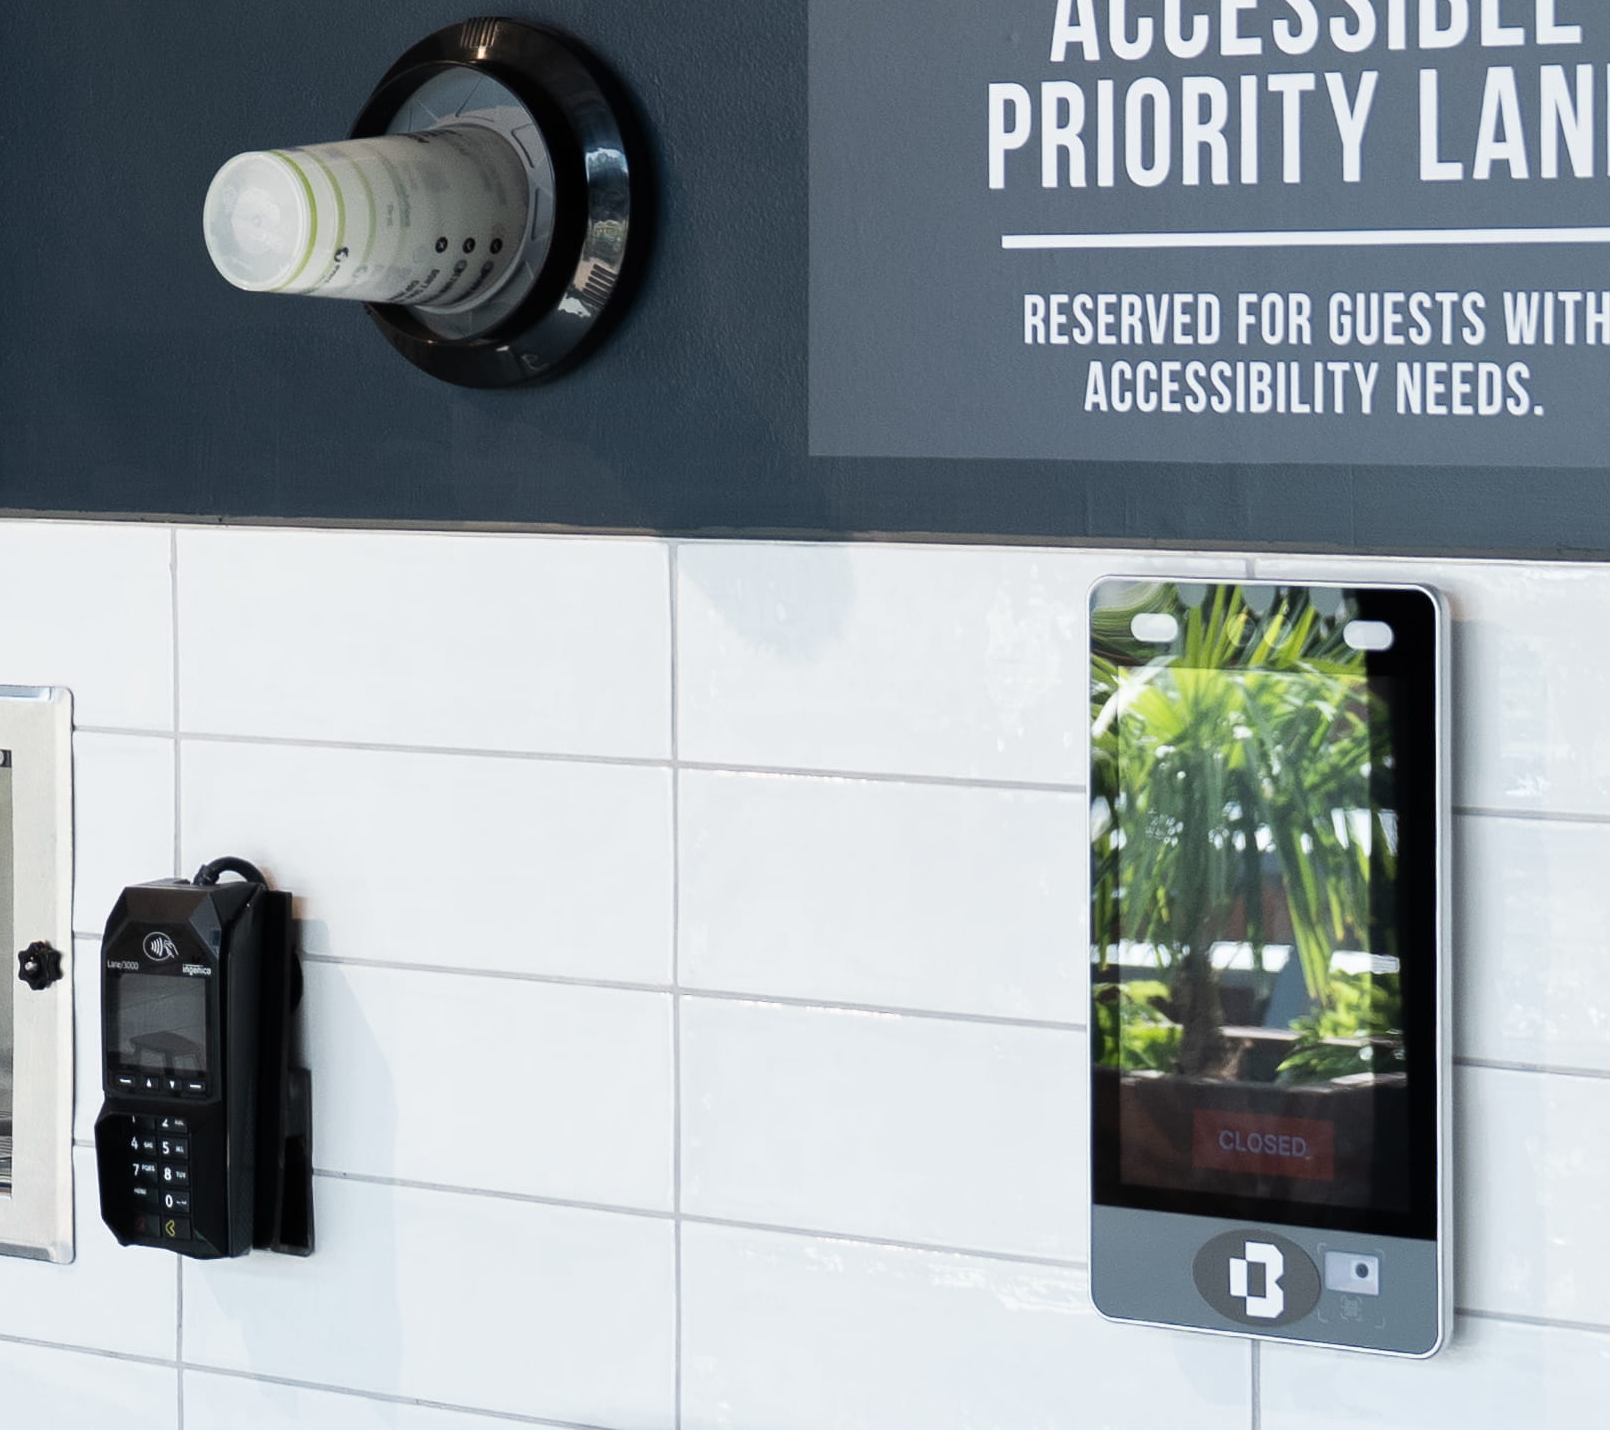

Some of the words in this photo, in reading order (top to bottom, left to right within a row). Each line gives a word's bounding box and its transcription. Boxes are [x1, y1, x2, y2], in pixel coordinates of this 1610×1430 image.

[988, 70, 1380, 190] PRIORITY
[1024, 292, 1221, 345] RESERVED
[1237, 292, 1313, 345] FOR
[1329, 291, 1486, 346] GUESTS
[1084, 361, 1380, 415] ACCESSIBILITY
[1396, 361, 1545, 416] NEEDS.
[130, 1136, 138, 1150] 4
[162, 1141, 170, 1155] 5
[1218, 1129, 1309, 1157] CLOSED
[132, 1163, 140, 1177] 7
[164, 1167, 172, 1181] 8
[165, 1194, 174, 1209] 0
